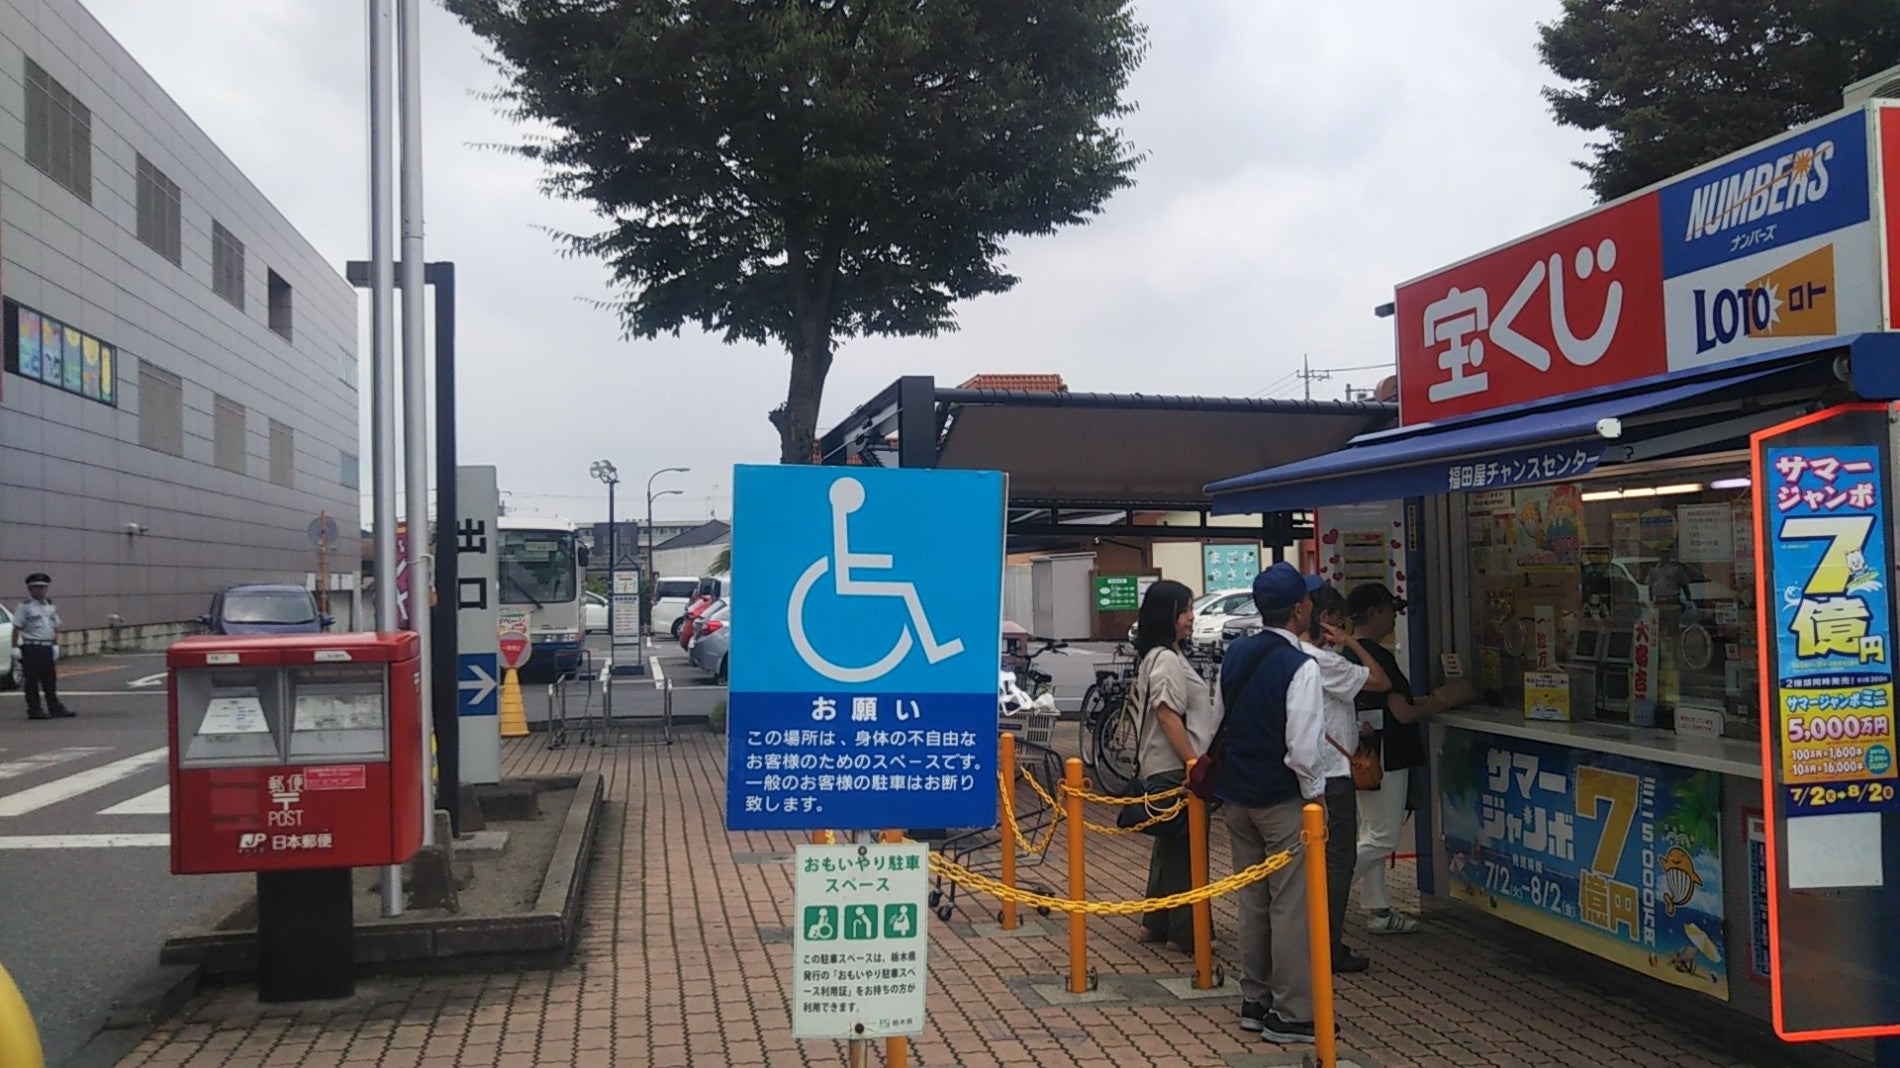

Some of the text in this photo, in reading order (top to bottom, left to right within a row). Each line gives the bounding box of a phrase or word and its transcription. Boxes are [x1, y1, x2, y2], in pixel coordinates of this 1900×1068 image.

[1685, 140, 1834, 242] NUMBERS
[1730, 224, 1778, 252] ナンバーズ
[1788, 282, 1827, 312] ロト
[1423, 238, 1623, 404] 宝くじ
[1694, 286, 1771, 354] LOTO
[1448, 449, 1601, 490] 福田屋チャンスセンター
[1775, 455, 1875, 484] サマー
[1777, 482, 1876, 512] ジャンボ
[458, 518, 487, 610] 出口
[811, 696, 921, 722] お願い
[1786, 689, 1888, 713] サマージャンボミニ
[747, 730, 977, 748] この場所は、身体の不自由な
[1787, 715, 1889, 743] 5,000万円
[746, 753, 982, 770] お客様のためのスペースです。
[1487, 748, 1567, 800] サマー
[268, 774, 304, 793] 郵便
[745, 774, 975, 792] 一般のお客様の駐車はお断り
[745, 795, 824, 813] 致します。
[268, 810, 304, 827] POST
[1482, 793, 1575, 862] ジャンボ
[272, 833, 333, 850] 日本郵便
[804, 855, 921, 873] おもいやり駐車
[825, 878, 890, 893] スペース
[803, 968, 917, 981] 発行の「おもいやり駐車スペ
[803, 984, 916, 997] ース利用証」をお持ちの方が
[803, 1002, 860, 1014] 利用できます。
